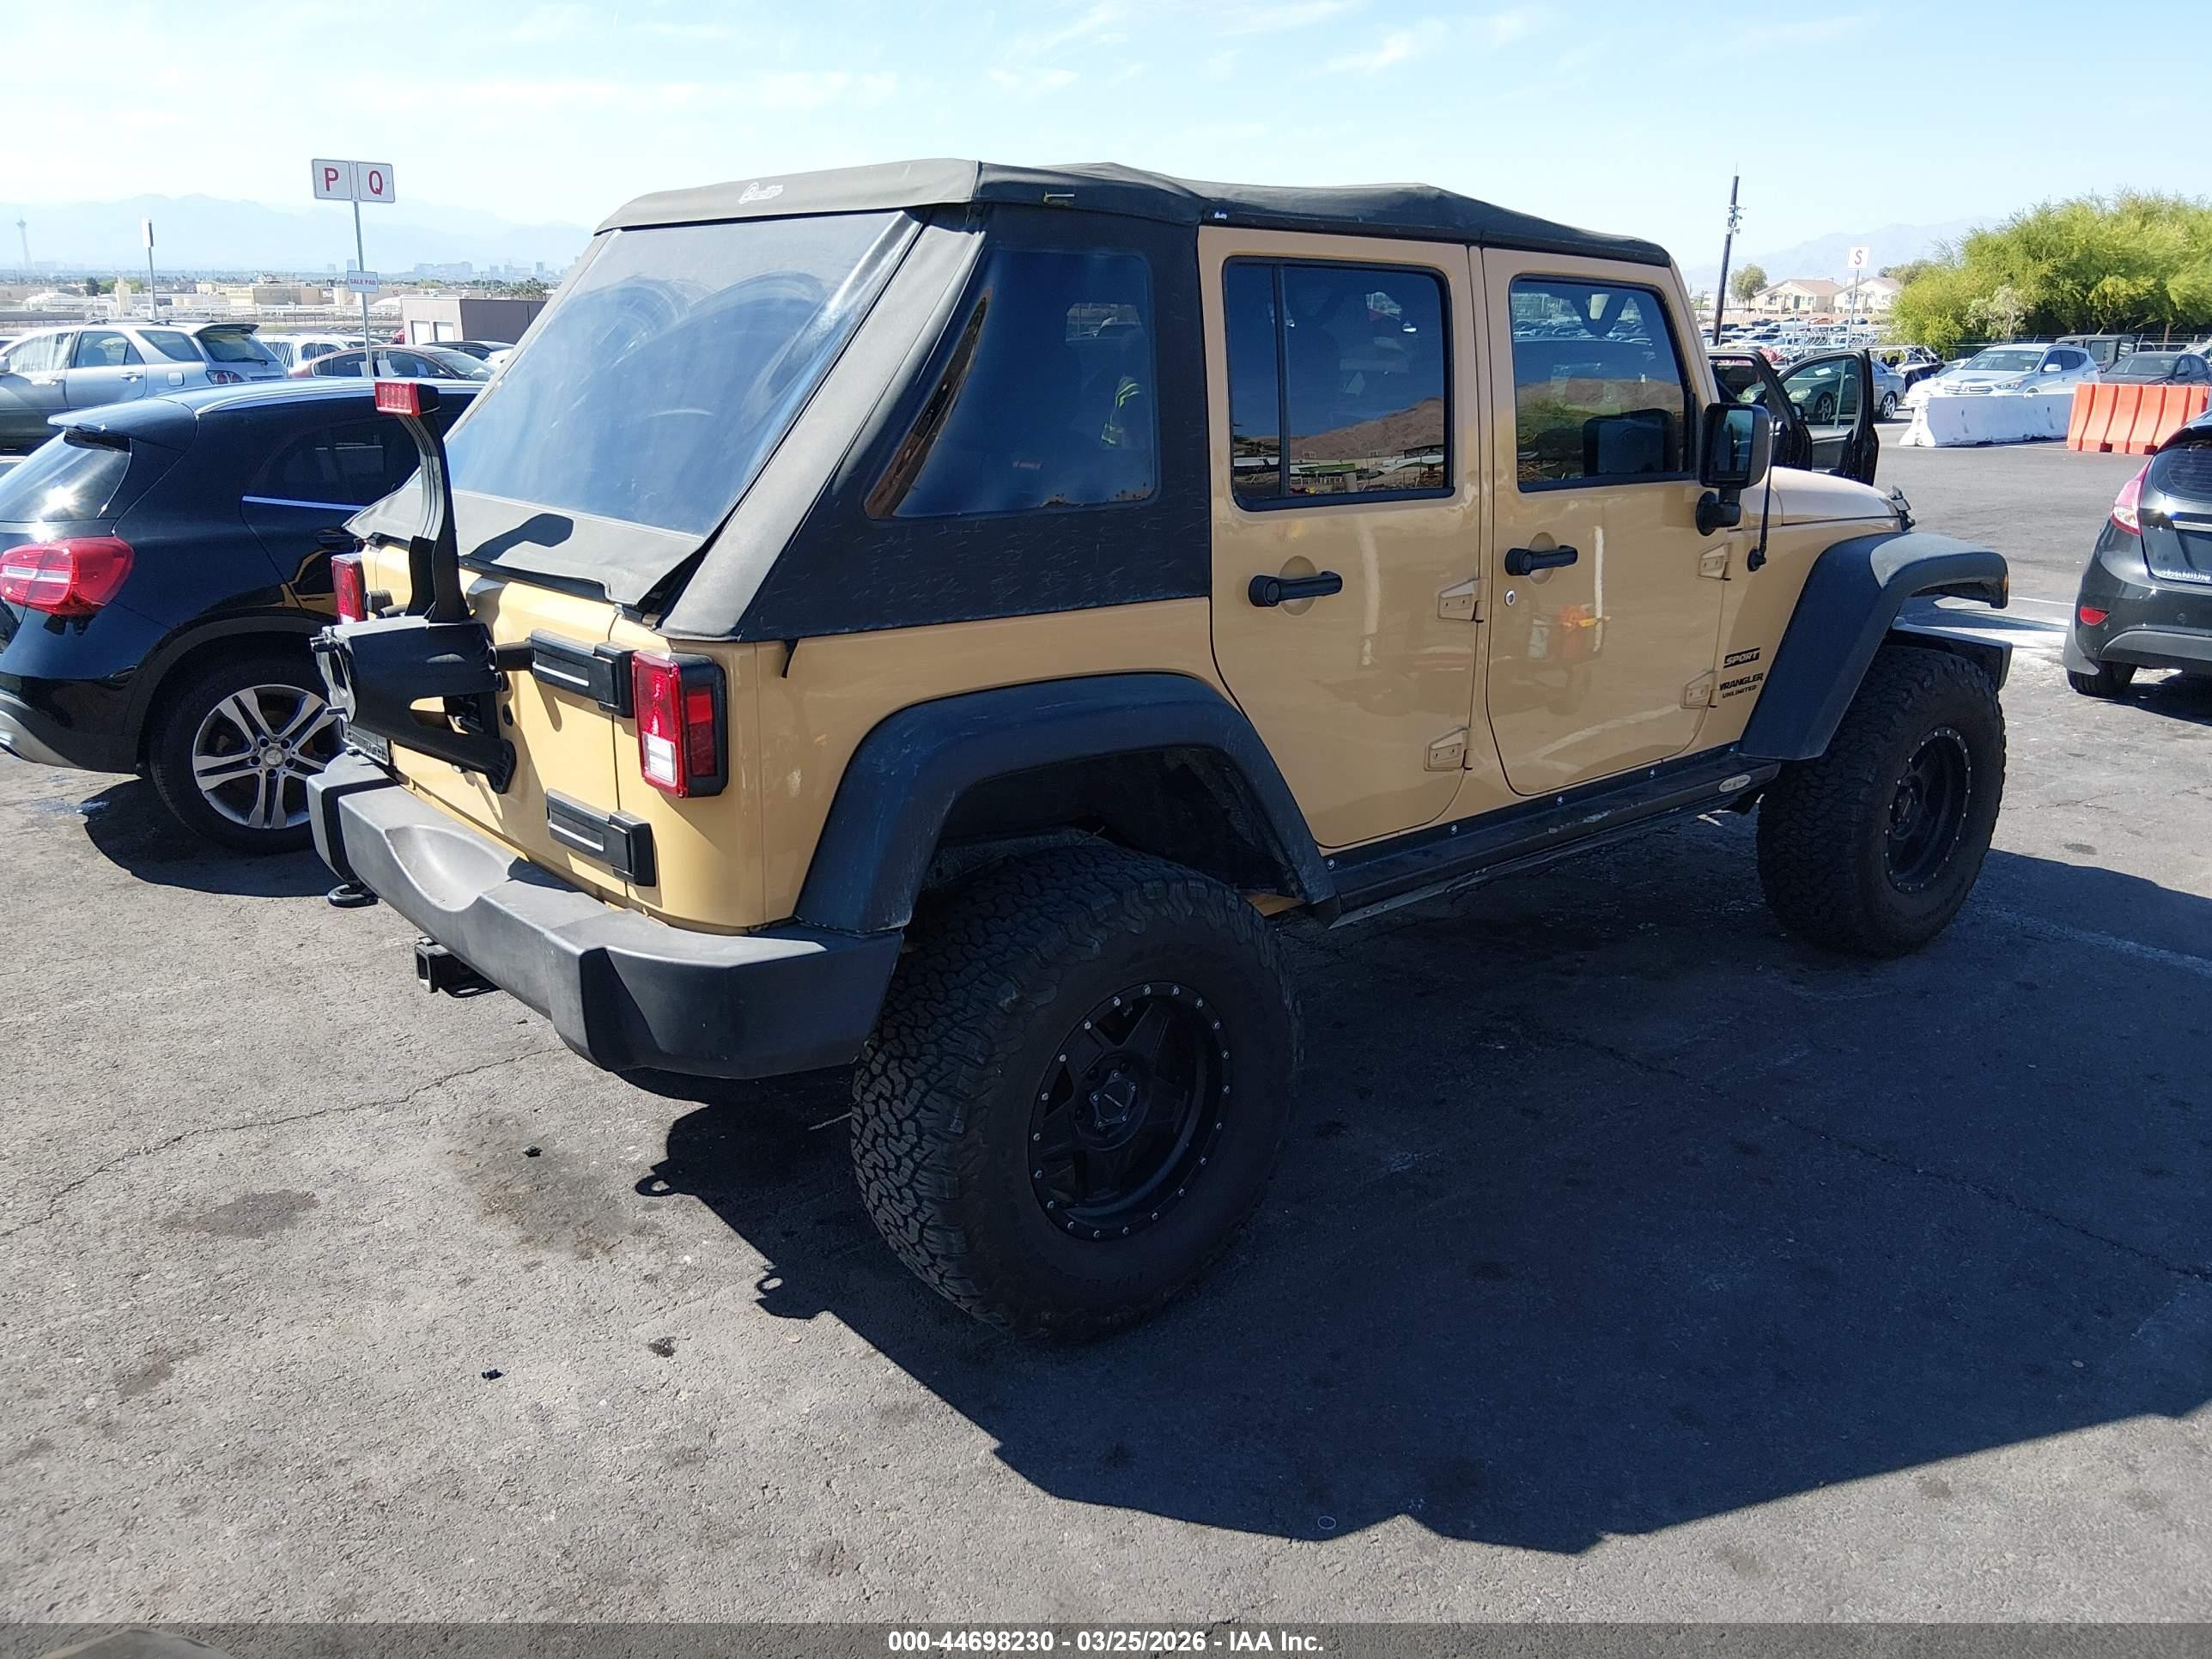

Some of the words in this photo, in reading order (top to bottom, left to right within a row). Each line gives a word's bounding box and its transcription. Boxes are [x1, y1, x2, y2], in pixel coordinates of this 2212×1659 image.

[324, 167, 339, 191] P
[368, 170, 383, 196] Q
[1854, 249, 1863, 265] S
[1725, 649, 1759, 665] SPORT
[1722, 684, 1758, 698] UNLIMITED
